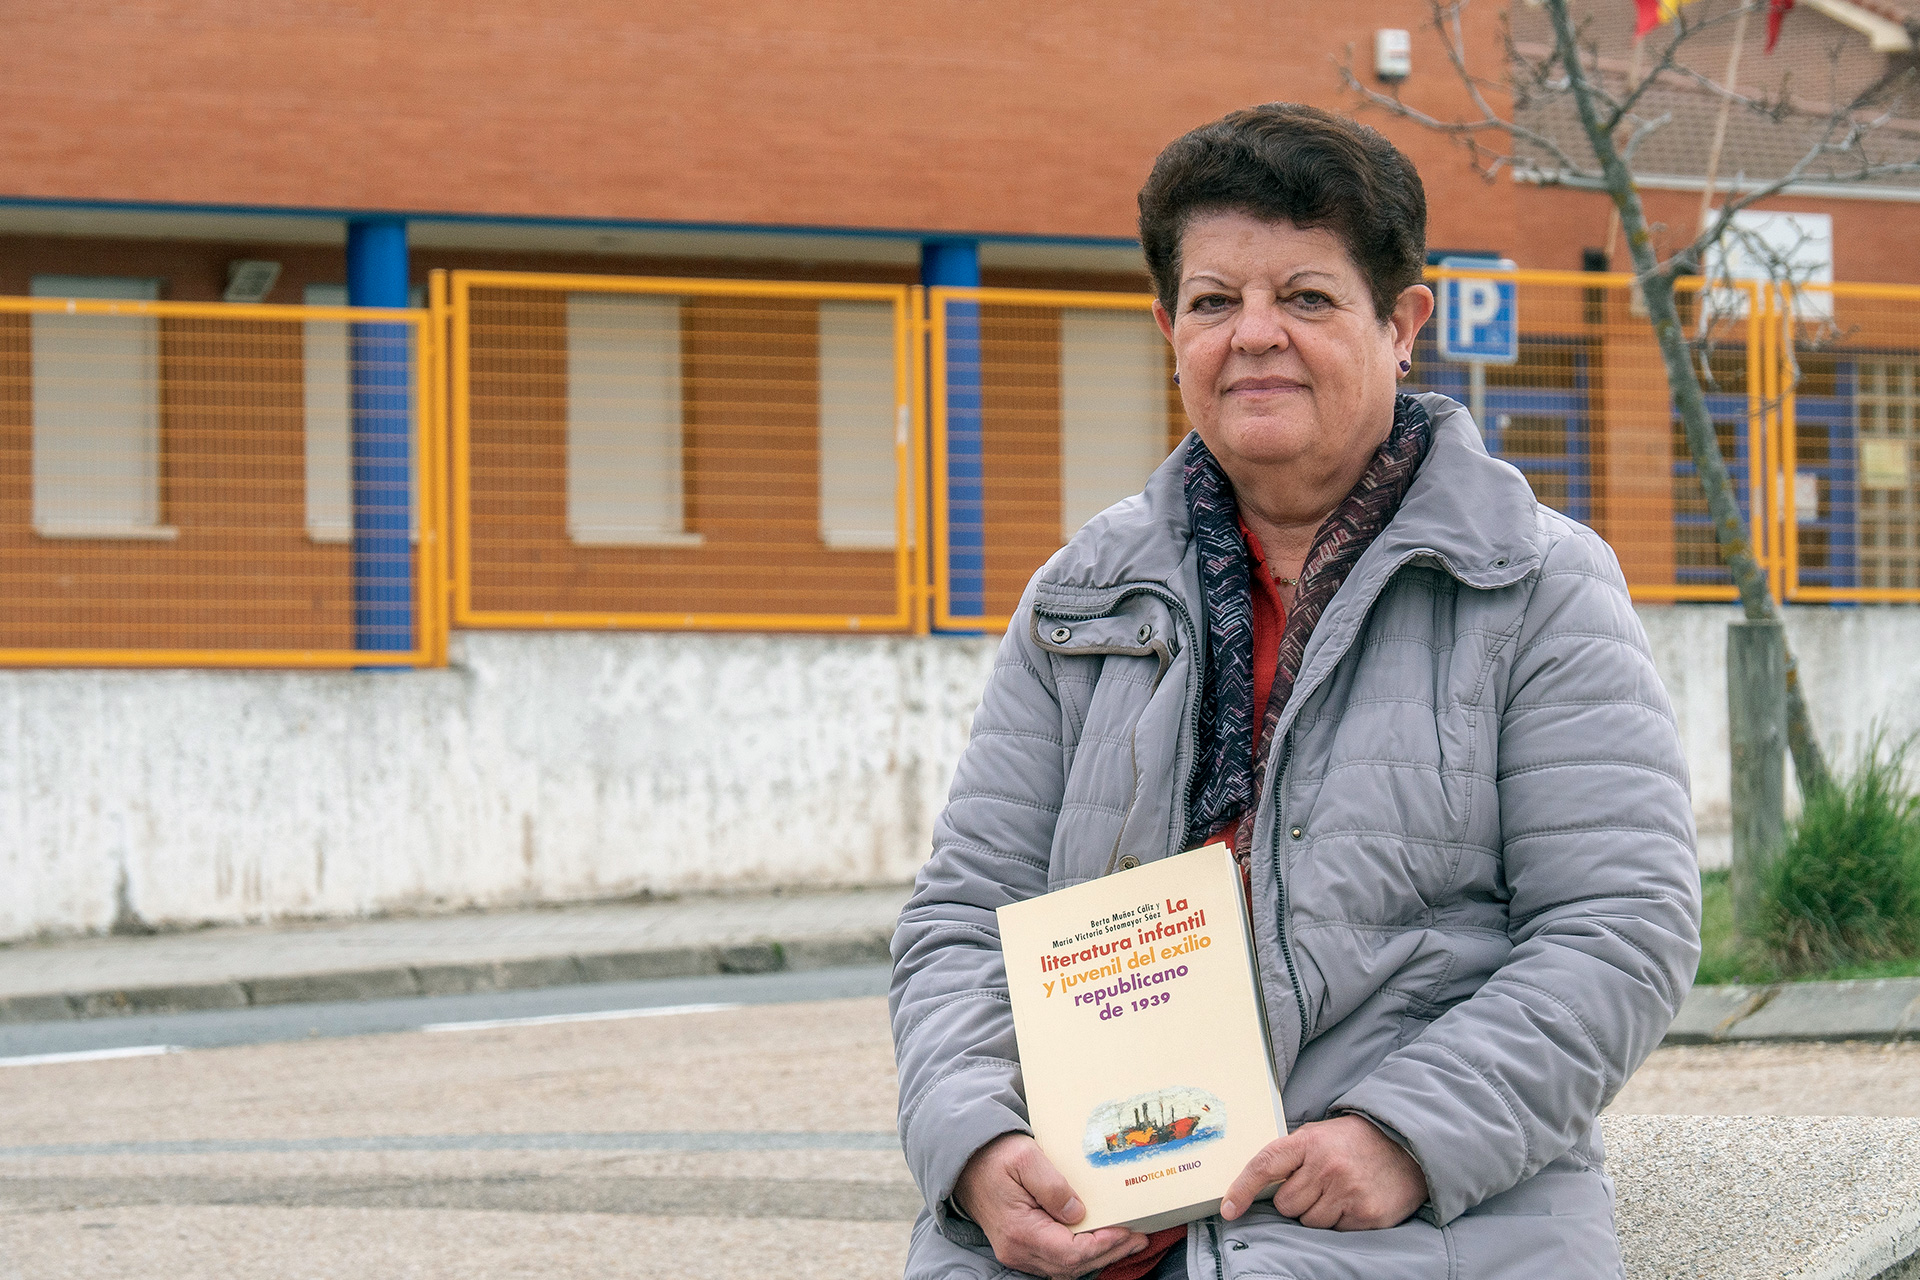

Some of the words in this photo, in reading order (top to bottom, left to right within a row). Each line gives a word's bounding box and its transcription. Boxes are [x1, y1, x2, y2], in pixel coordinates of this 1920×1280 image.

[1459, 277, 1500, 347] P
[1091, 918, 1110, 928] Berta
[1112, 910, 1135, 922] Muñoz
[1137, 904, 1154, 914] Cáliz
[1166, 898, 1188, 914] La
[1041, 937, 1132, 973] literatura
[1137, 909, 1206, 945] infantil
[1052, 938, 1073, 948] María
[1075, 928, 1103, 942] Victoria
[1105, 918, 1142, 933] Sotomayor
[1145, 912, 1161, 921] Sáez
[1042, 981, 1055, 998] y
[1060, 956, 1122, 993] juvenil
[1127, 946, 1156, 969] del
[1161, 934, 1211, 959] exilio
[1074, 965, 1189, 1006] republicano
[1099, 1003, 1124, 1021] de
[1131, 992, 1170, 1011] 1939
[1125, 1171, 1164, 1186] BIBLIOTECA
[1166, 1167, 1177, 1176] DEL
[1178, 1161, 1201, 1172] EXILIO
